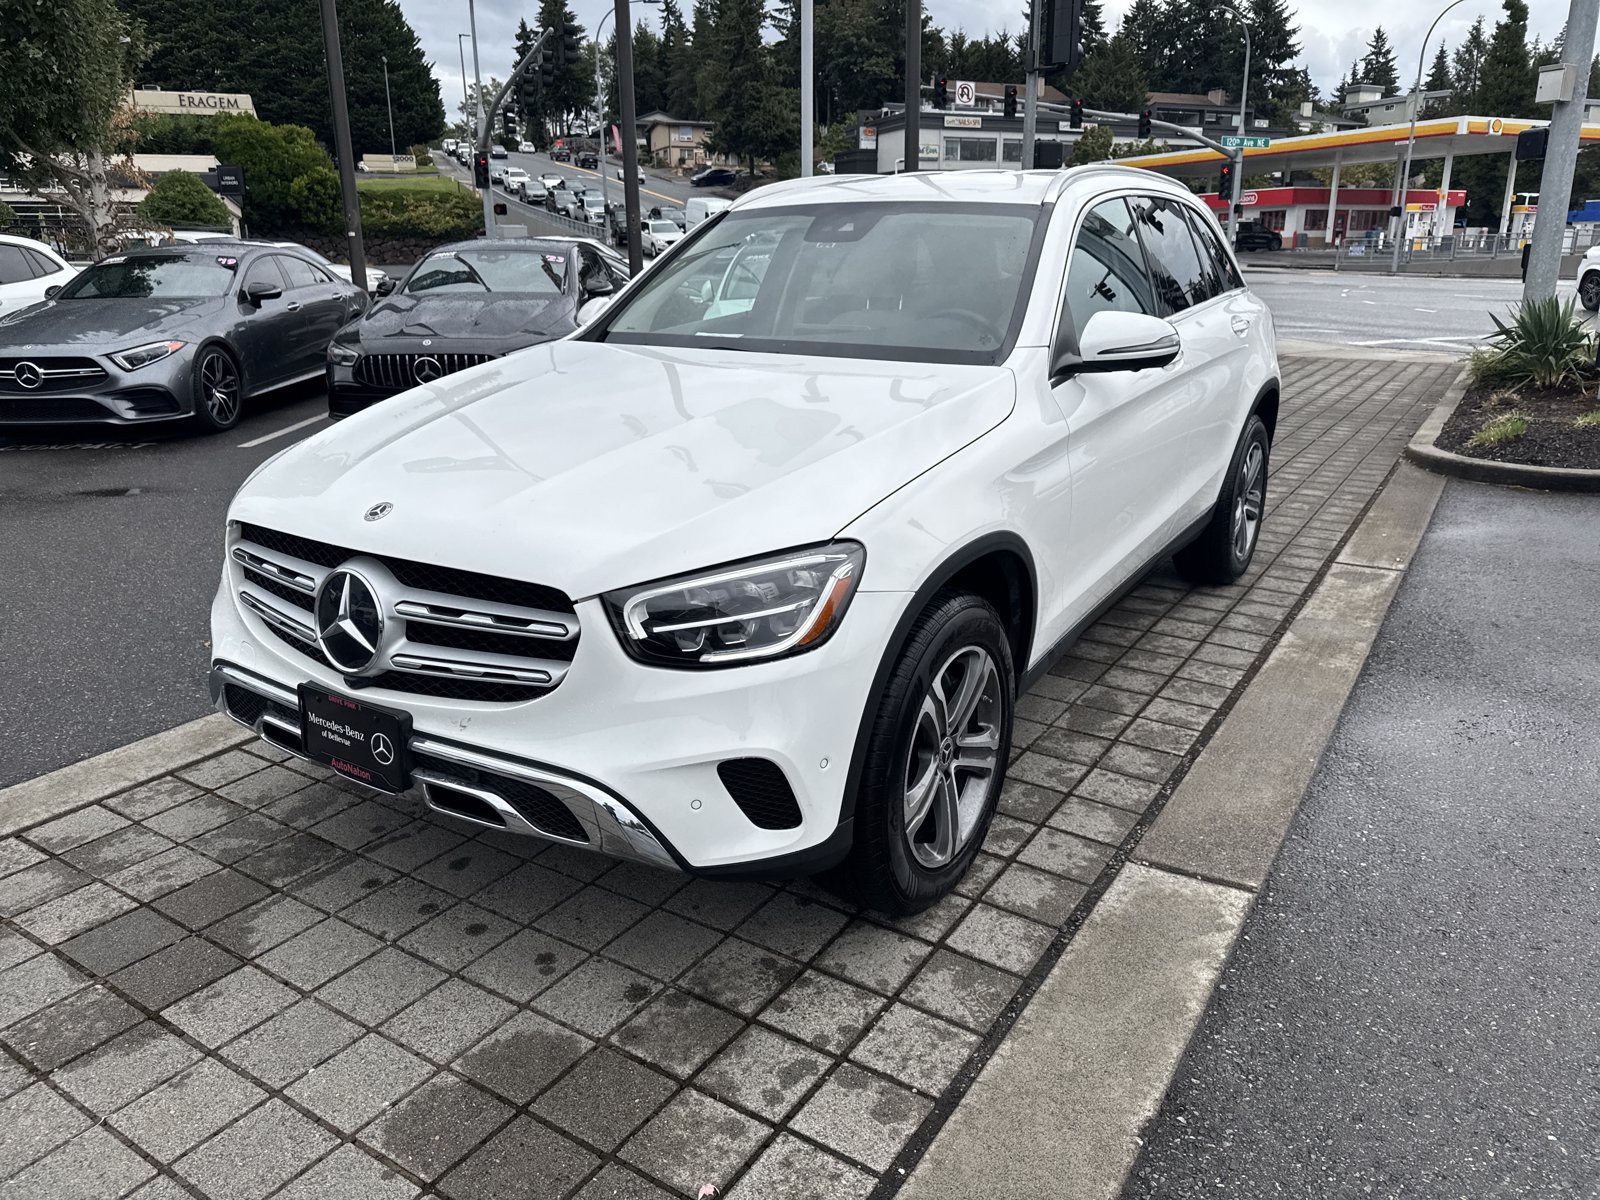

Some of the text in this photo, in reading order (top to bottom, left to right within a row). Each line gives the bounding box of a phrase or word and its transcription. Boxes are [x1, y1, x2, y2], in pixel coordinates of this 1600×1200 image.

[1243, 138, 1254, 147] Ave
[1256, 138, 1266, 147] NE
[308, 711, 365, 742] Mercedes-Benz
[321, 730, 351, 747] of Bellevue
[331, 757, 372, 781] AutoNation
